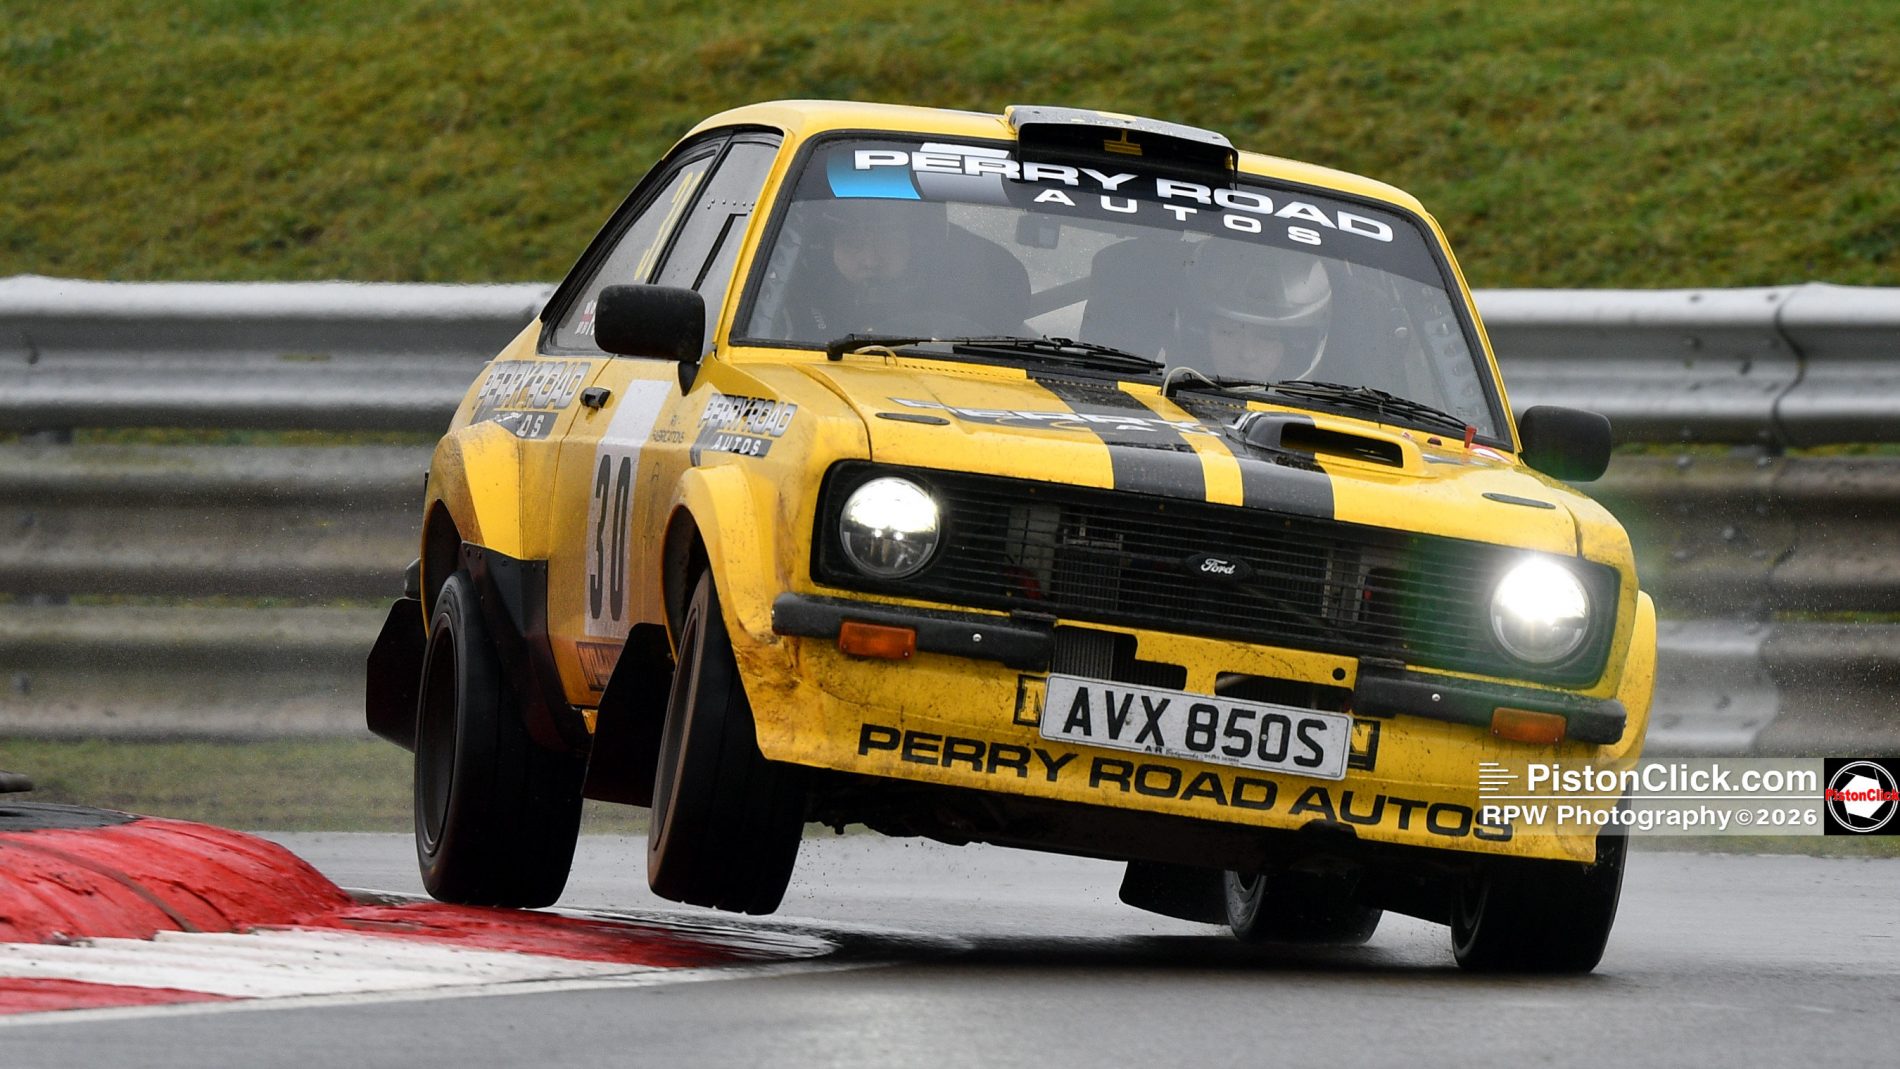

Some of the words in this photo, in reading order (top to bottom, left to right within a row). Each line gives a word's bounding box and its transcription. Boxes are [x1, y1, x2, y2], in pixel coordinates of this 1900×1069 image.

[854, 149, 1138, 190] PERRY
[1156, 177, 1393, 243] ROAD
[1034, 188, 1321, 246] AUTOS
[524, 361, 592, 409] ROAD
[697, 393, 755, 431] PERRY
[741, 398, 798, 438] ROAD
[711, 434, 762, 456] AUTOS
[590, 455, 631, 622] 30
[1200, 558, 1236, 575] Ford
[1062, 686, 1171, 746] AVX
[1184, 702, 1328, 768] 850S
[857, 722, 1079, 782] PERRY
[1088, 755, 1279, 812] ROAD
[1288, 785, 1513, 843] AUTOS
